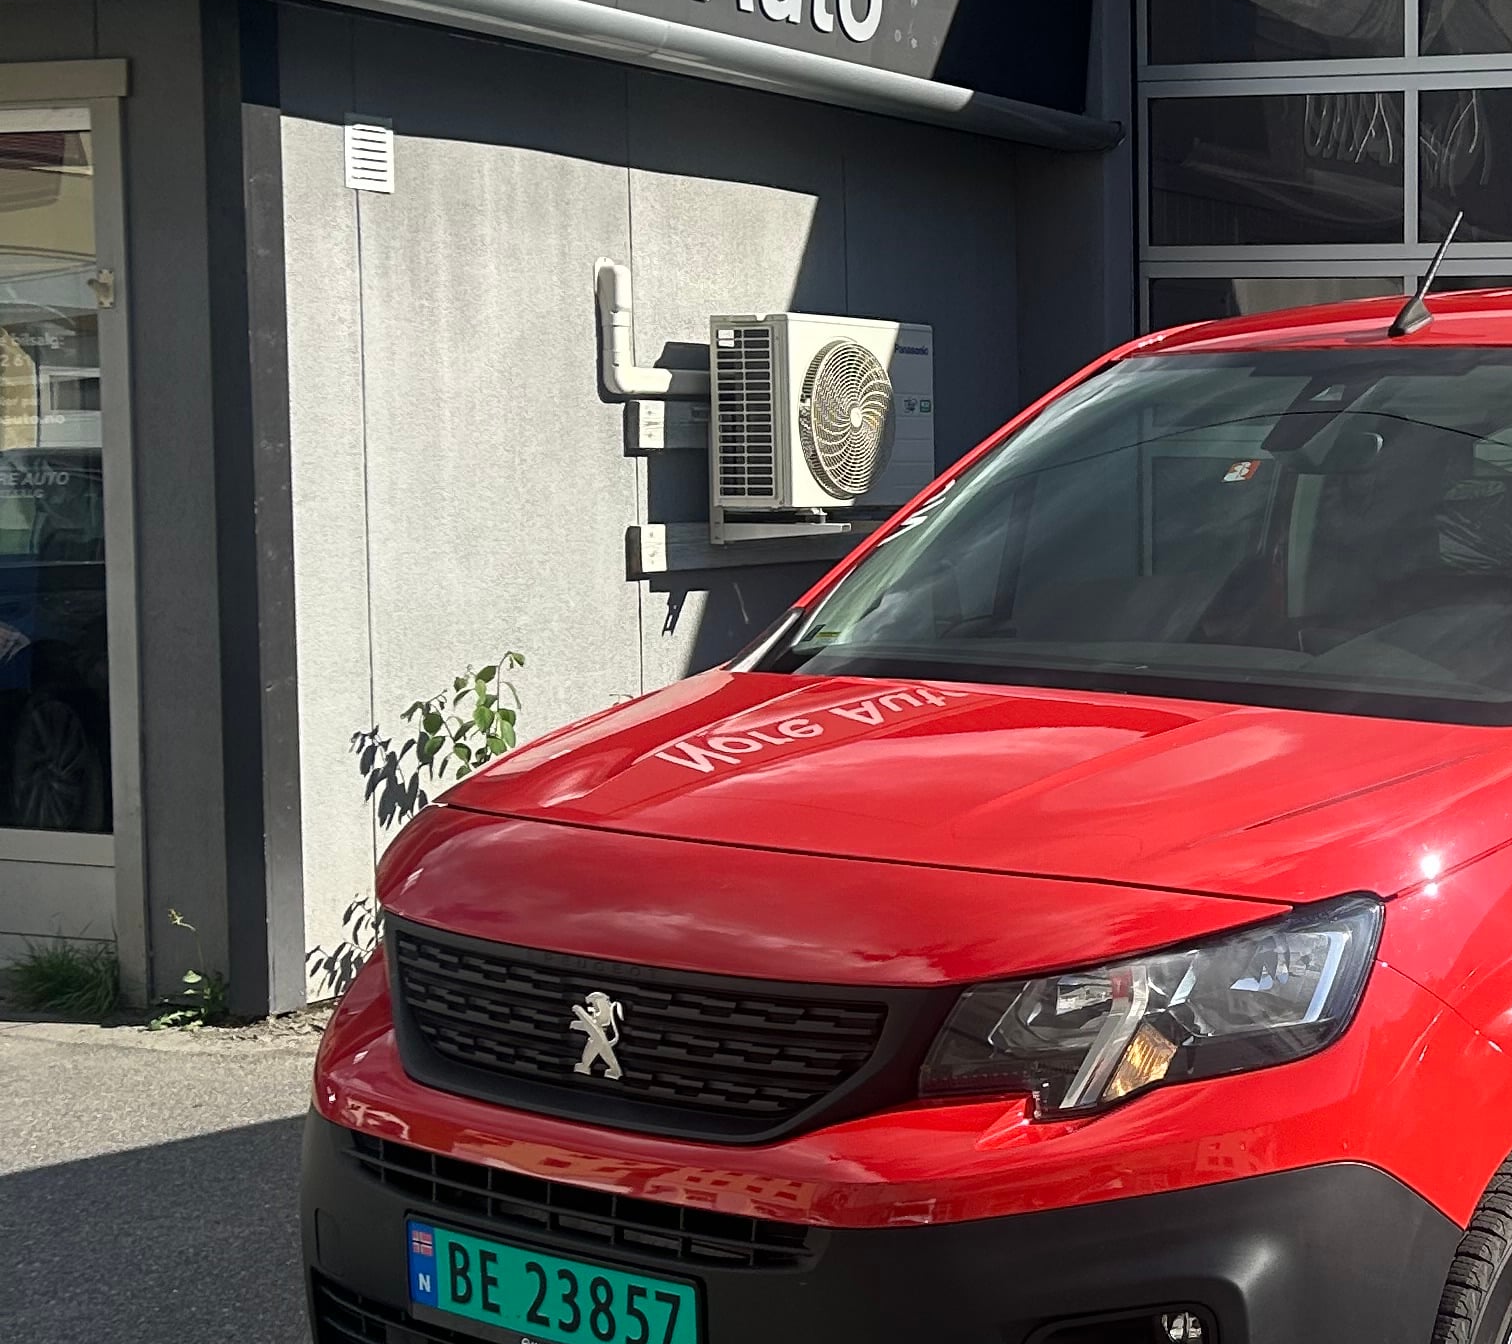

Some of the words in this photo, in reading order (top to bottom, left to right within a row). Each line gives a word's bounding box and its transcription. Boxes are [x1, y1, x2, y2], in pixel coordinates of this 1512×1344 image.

[20, 471, 70, 486] AUTO
[543, 951, 658, 979] PEUGEOT
[418, 1272, 431, 1293] N
[448, 1240, 500, 1313] BE
